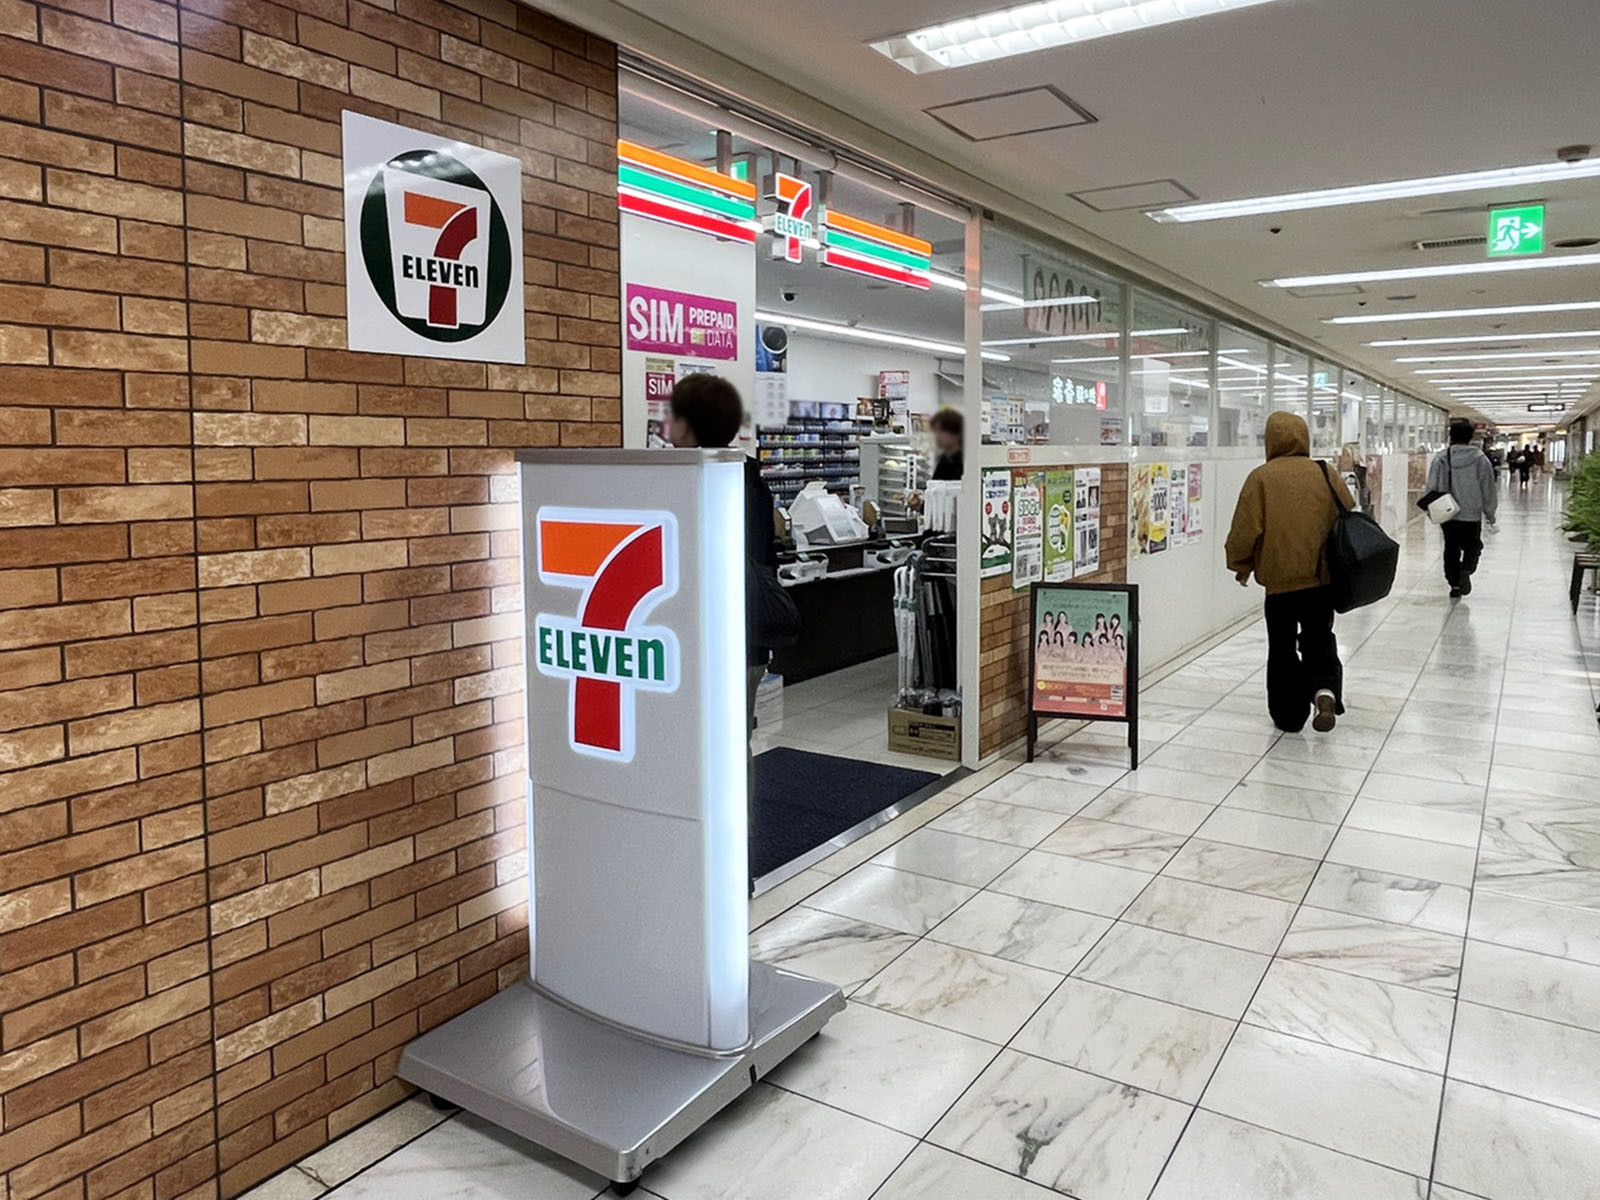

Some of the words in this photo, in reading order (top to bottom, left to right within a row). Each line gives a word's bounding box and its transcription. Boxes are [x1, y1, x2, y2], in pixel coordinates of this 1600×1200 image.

[777, 176, 810, 260] 7
[404, 191, 478, 326] 7
[628, 295, 684, 345] SIM
[688, 306, 734, 330] PREPAID
[706, 329, 734, 349] DATA
[648, 378, 673, 396] SIM
[540, 520, 663, 752] 7
